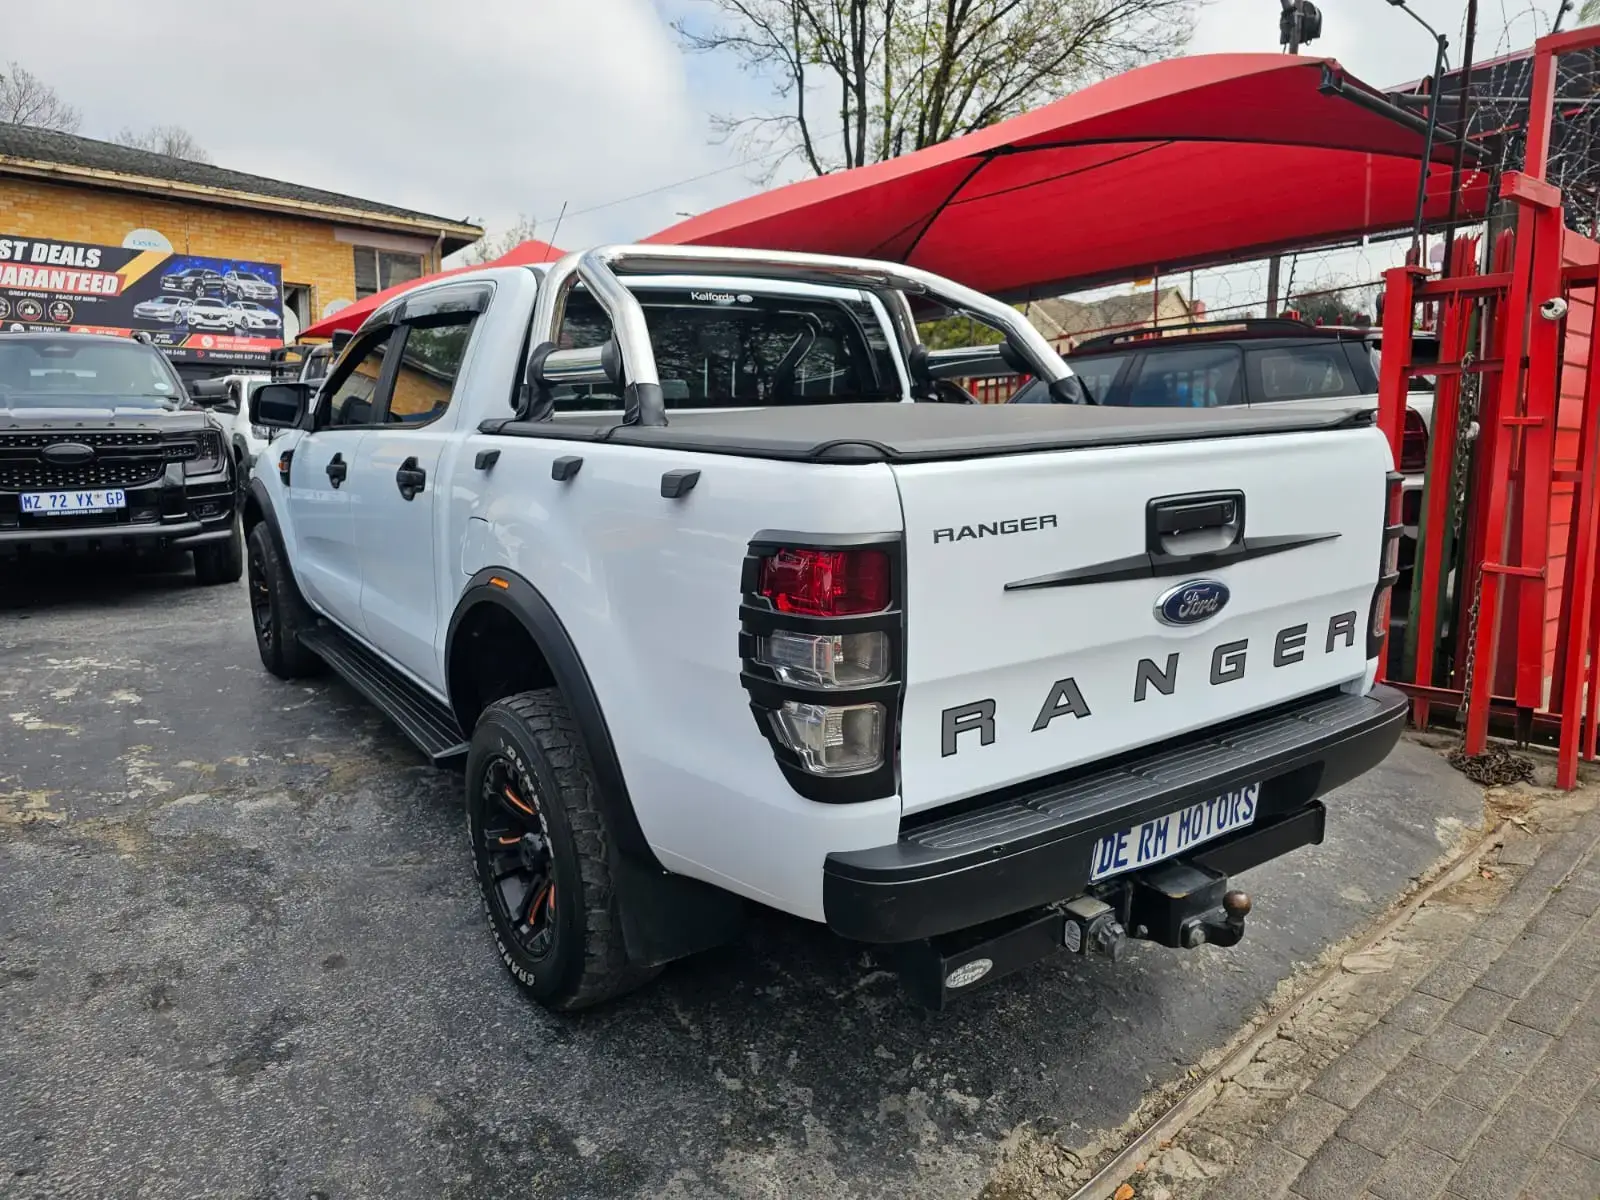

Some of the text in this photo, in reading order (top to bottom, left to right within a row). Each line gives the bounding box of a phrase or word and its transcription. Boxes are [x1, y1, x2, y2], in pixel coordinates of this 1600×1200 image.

[30, 242, 102, 268] DEALS
[0, 265, 118, 293] ARANTEED
[8, 289, 27, 297] GREAT
[27, 291, 48, 299] PRICES
[690, 291, 736, 302] Kelfords
[23, 491, 123, 509] MZ 72 YX GP
[933, 514, 1058, 544] RANGER
[1177, 587, 1221, 619] Ford
[941, 610, 1357, 758] RANGER
[1096, 784, 1257, 875] DE RM MOTORS
